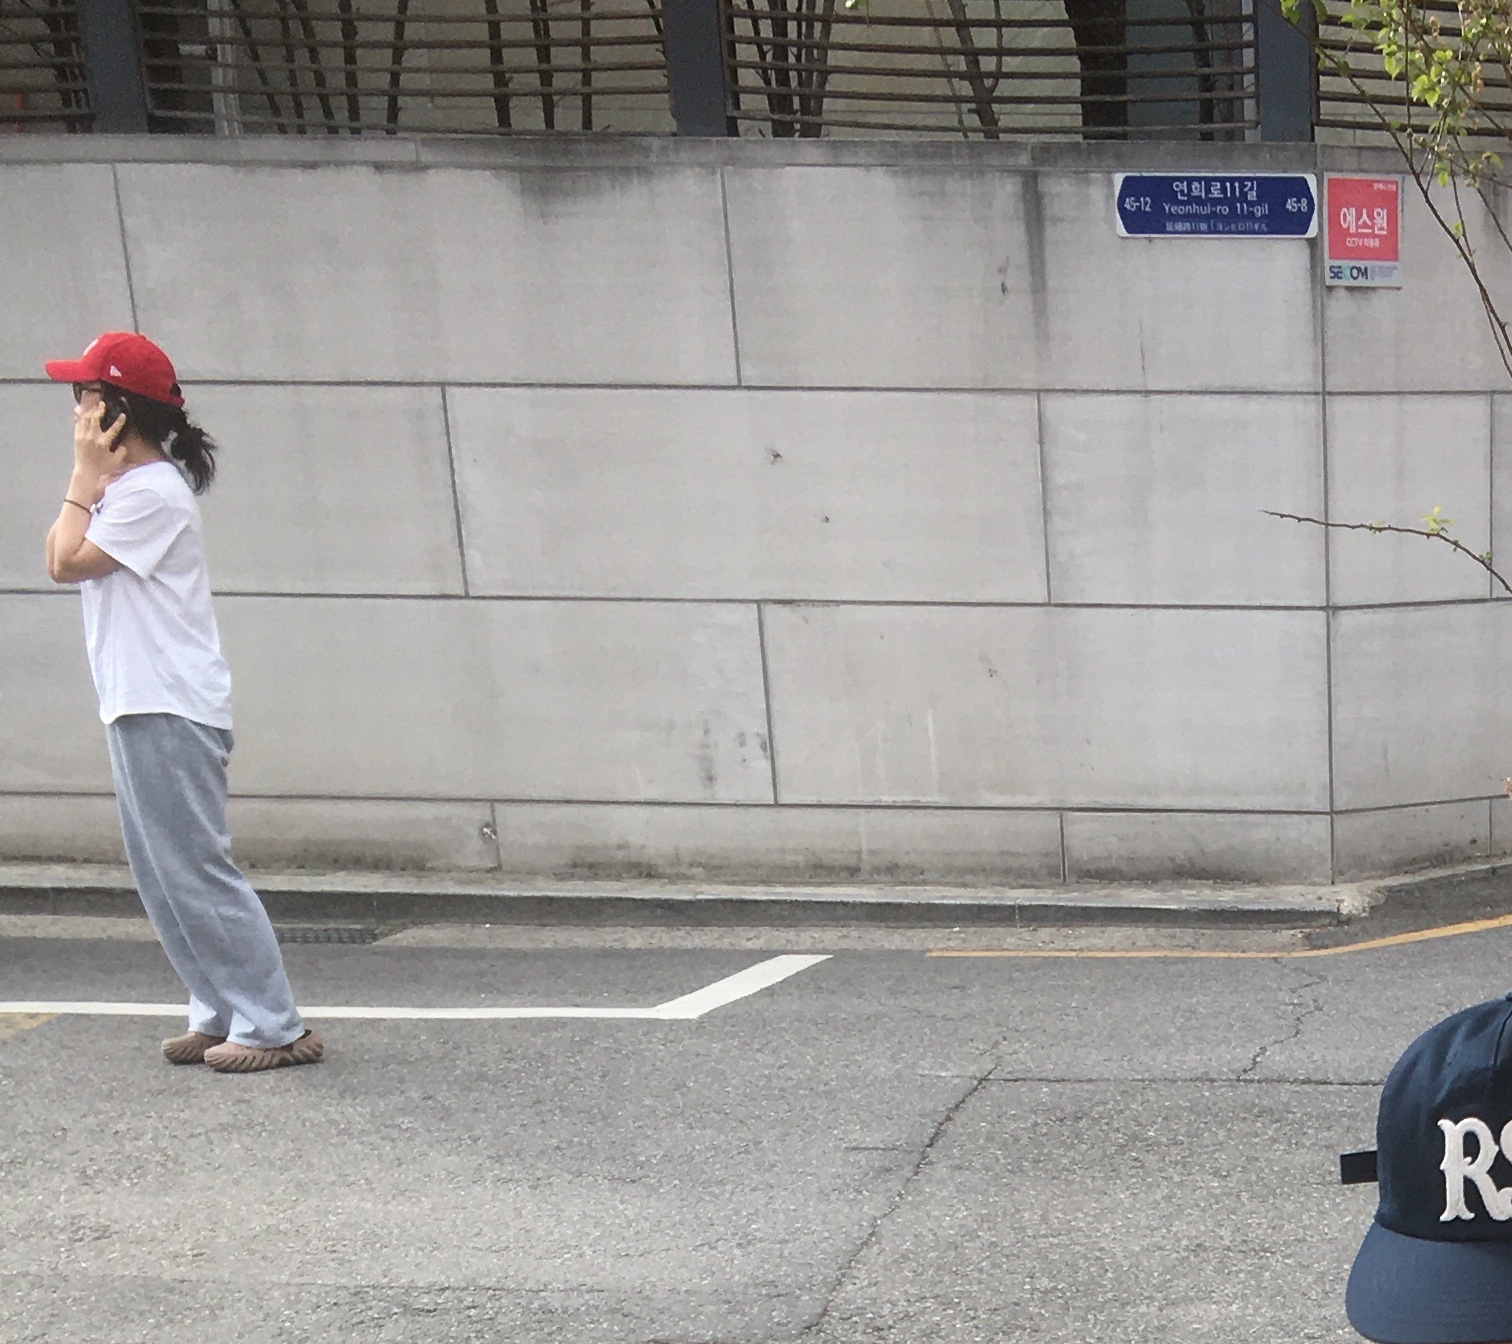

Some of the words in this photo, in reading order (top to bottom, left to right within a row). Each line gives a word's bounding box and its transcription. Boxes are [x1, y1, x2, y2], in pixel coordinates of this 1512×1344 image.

[1172, 180, 1258, 201] 연희로11길
[1123, 196, 1152, 212] 45-12
[1162, 202, 1230, 215] Yeonhui-ro
[1236, 202, 1269, 218] 11-gil
[1285, 197, 1308, 213] 45-8
[1340, 207, 1388, 235] 에스원
[1329, 265, 1369, 281] SECOM
